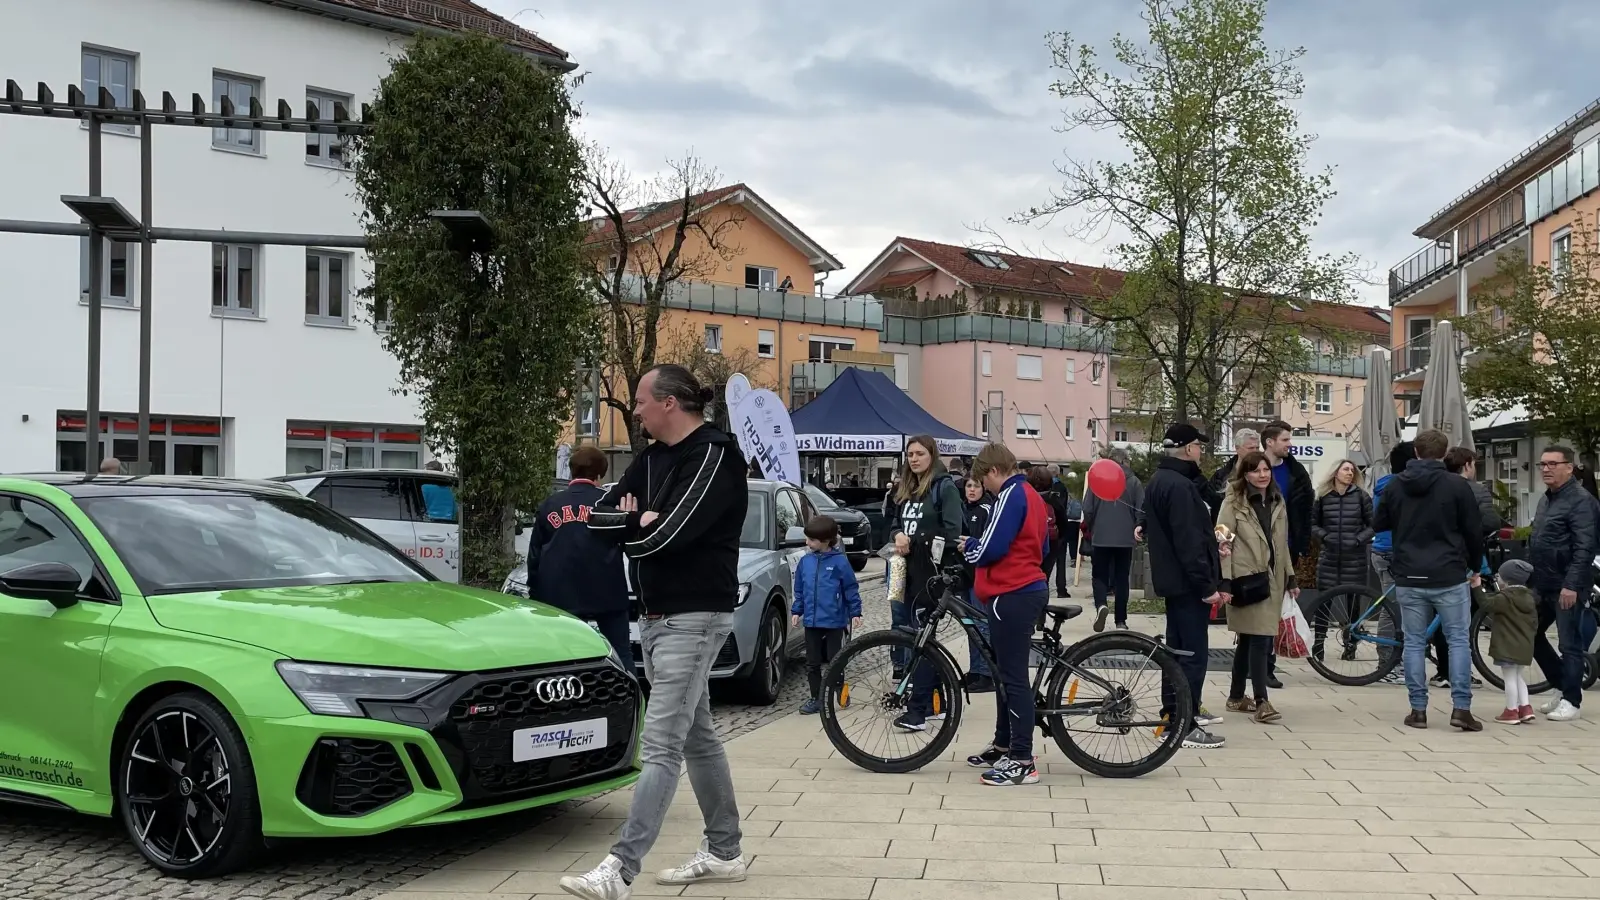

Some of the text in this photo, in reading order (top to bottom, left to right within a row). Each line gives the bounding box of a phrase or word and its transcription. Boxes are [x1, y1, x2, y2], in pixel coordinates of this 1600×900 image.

[814, 436, 885, 450] Widmann
[420, 546, 444, 558] ID.3
[30, 756, 74, 770] 08141-2940
